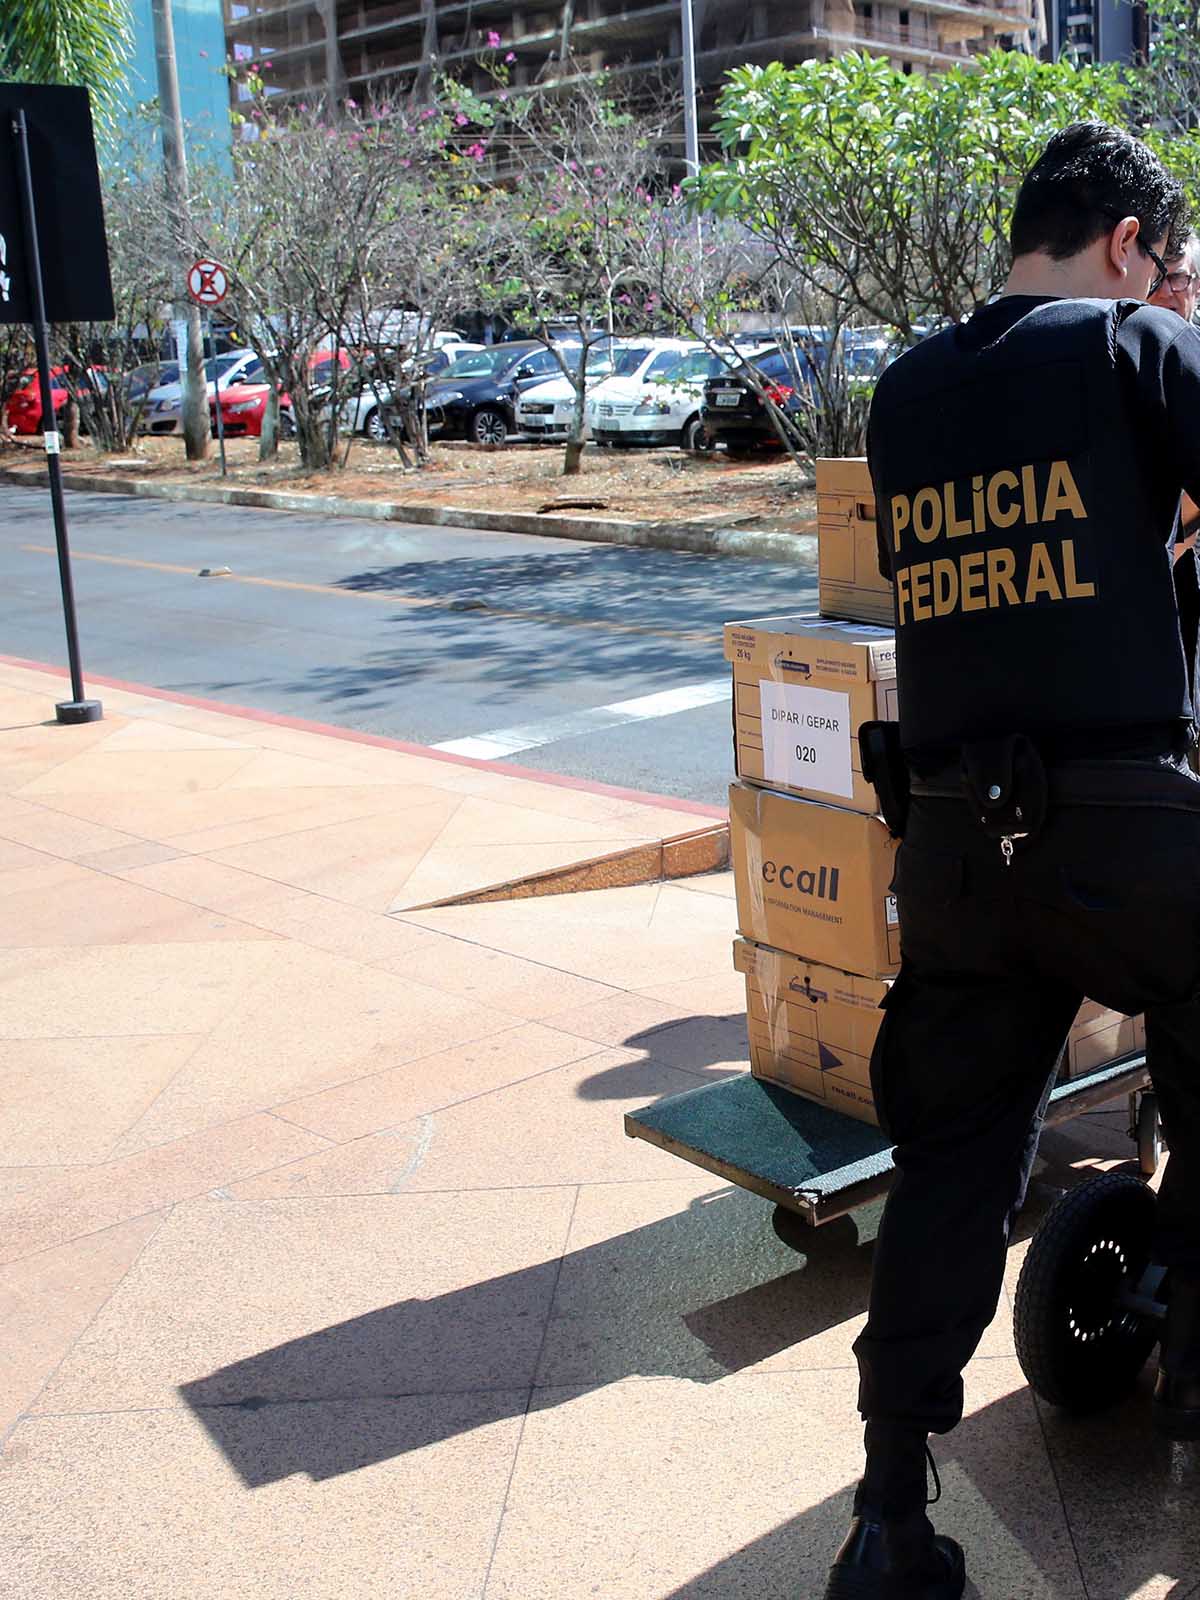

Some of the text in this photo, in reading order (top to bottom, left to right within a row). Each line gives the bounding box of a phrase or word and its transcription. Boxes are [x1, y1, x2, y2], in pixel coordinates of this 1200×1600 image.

[891, 460, 1088, 552] POLÍCIA
[896, 539, 1096, 626] FEDERAL
[771, 708, 840, 732] DIPAR / GEPAR
[795, 744, 816, 764] 020
[761, 860, 840, 902] ecall
